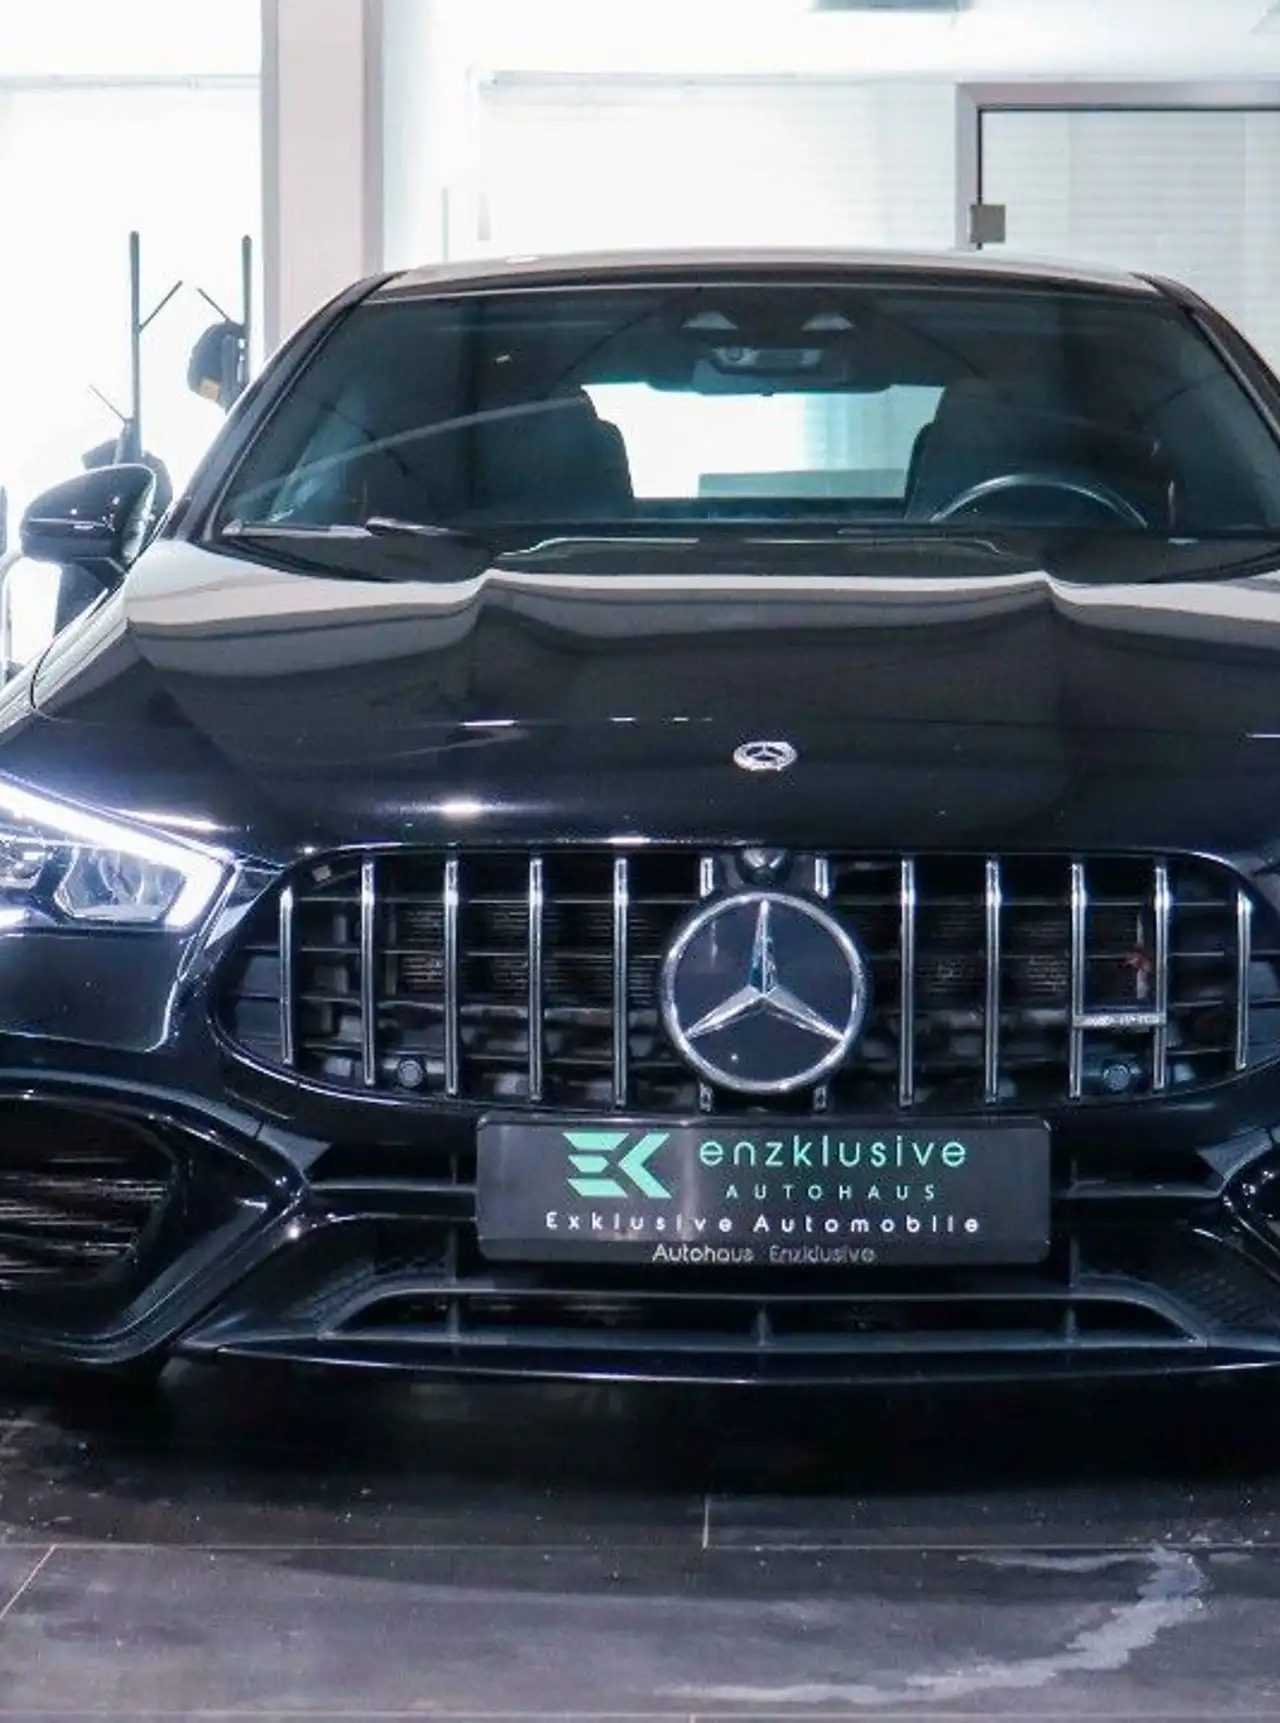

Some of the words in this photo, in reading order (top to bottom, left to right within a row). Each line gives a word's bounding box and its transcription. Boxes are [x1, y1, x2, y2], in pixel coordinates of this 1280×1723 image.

[699, 1135, 966, 1168] enzklusive
[726, 1184, 937, 1200] AUTOHAUS
[546, 1211, 733, 1233] Exklusive
[753, 1213, 980, 1233] Automobile
[652, 1243, 754, 1264] Autohaus
[769, 1244, 876, 1264] Enzklusive
